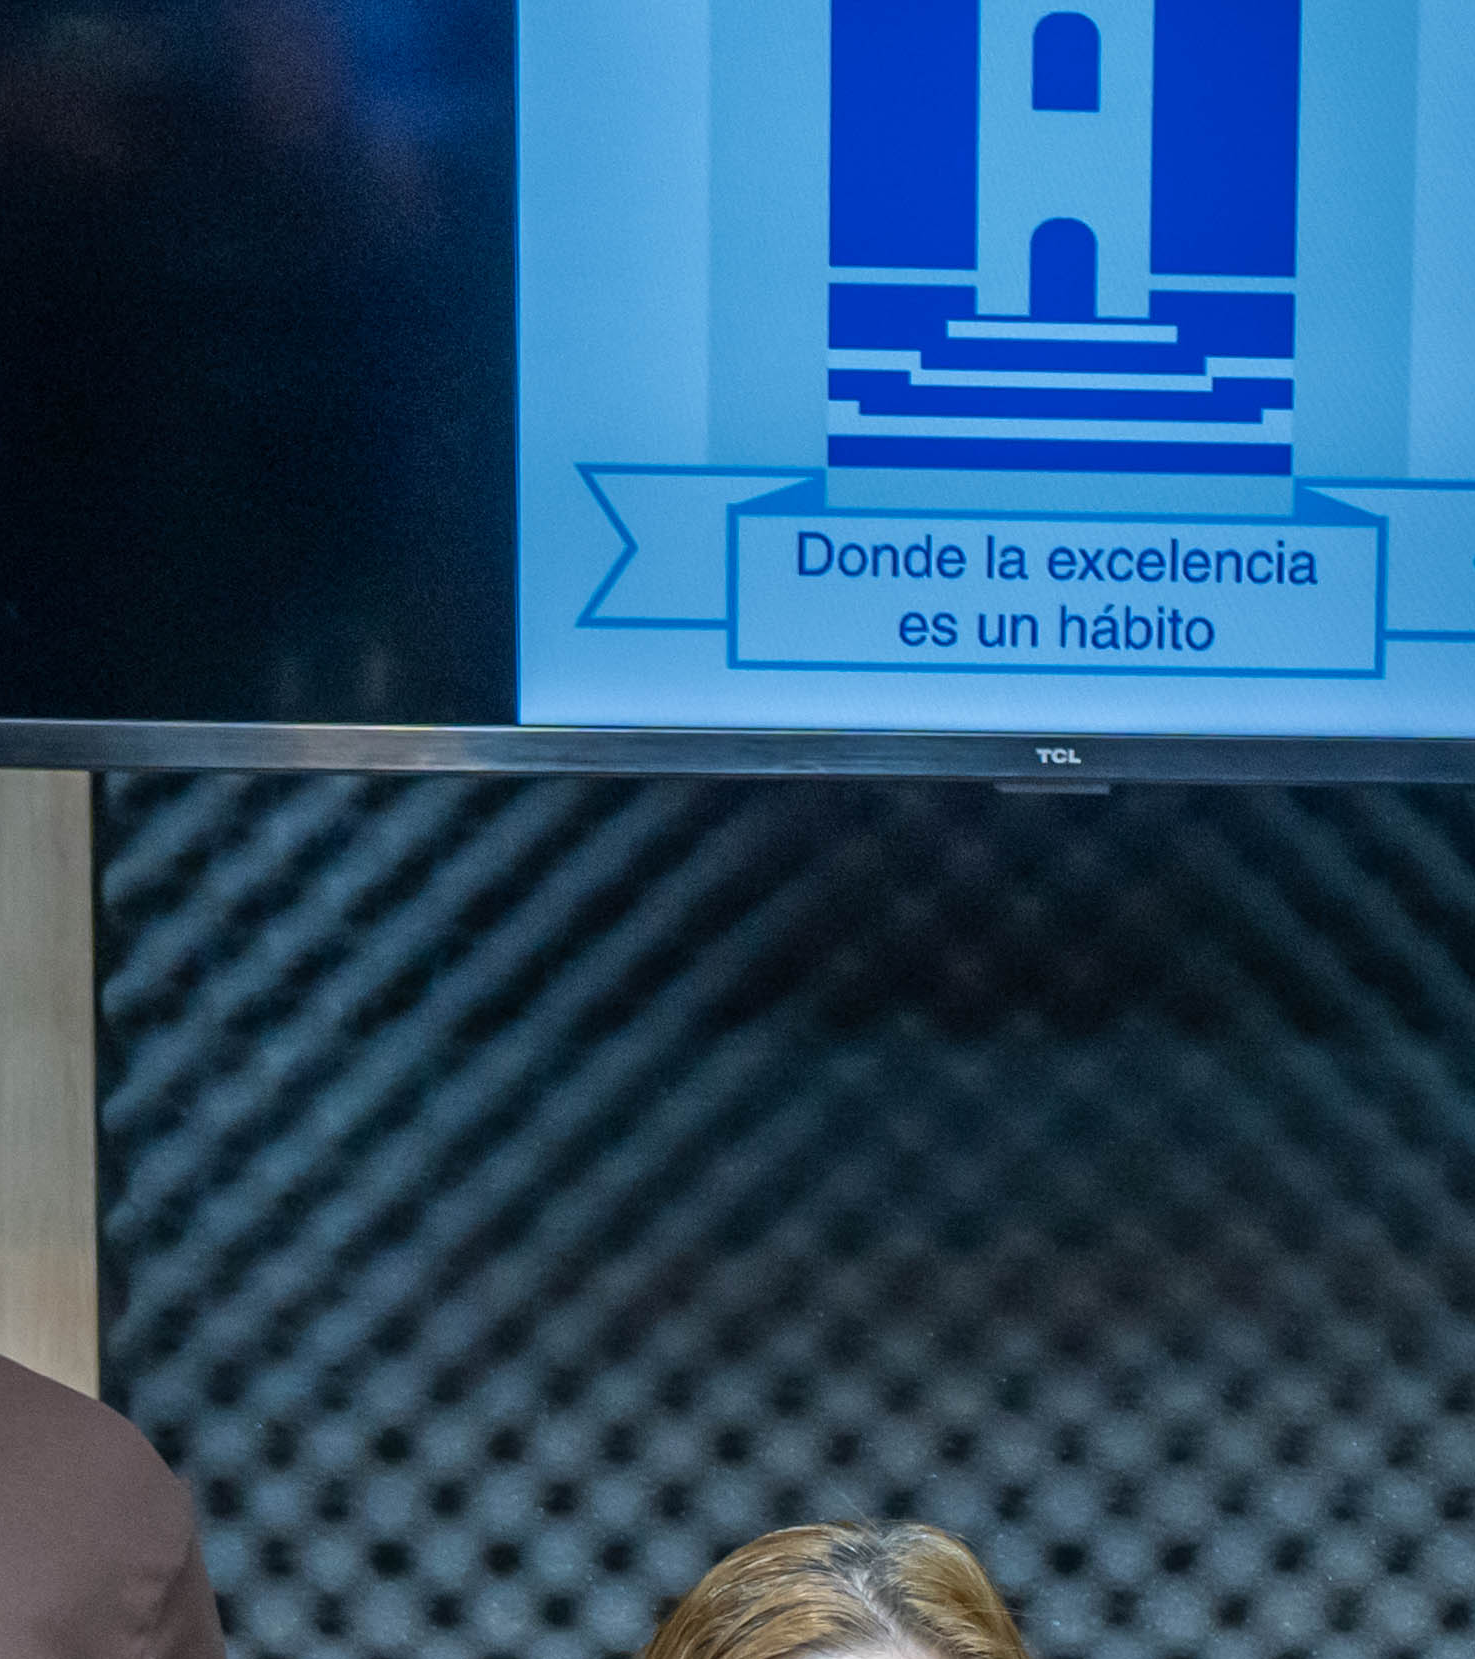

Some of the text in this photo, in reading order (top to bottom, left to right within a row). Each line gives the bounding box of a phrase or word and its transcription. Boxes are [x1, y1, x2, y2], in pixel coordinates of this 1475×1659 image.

[797, 531, 1318, 585] Donde la excelencia
[900, 604, 1215, 651] es un hábito
[1035, 748, 1082, 764] TCL
